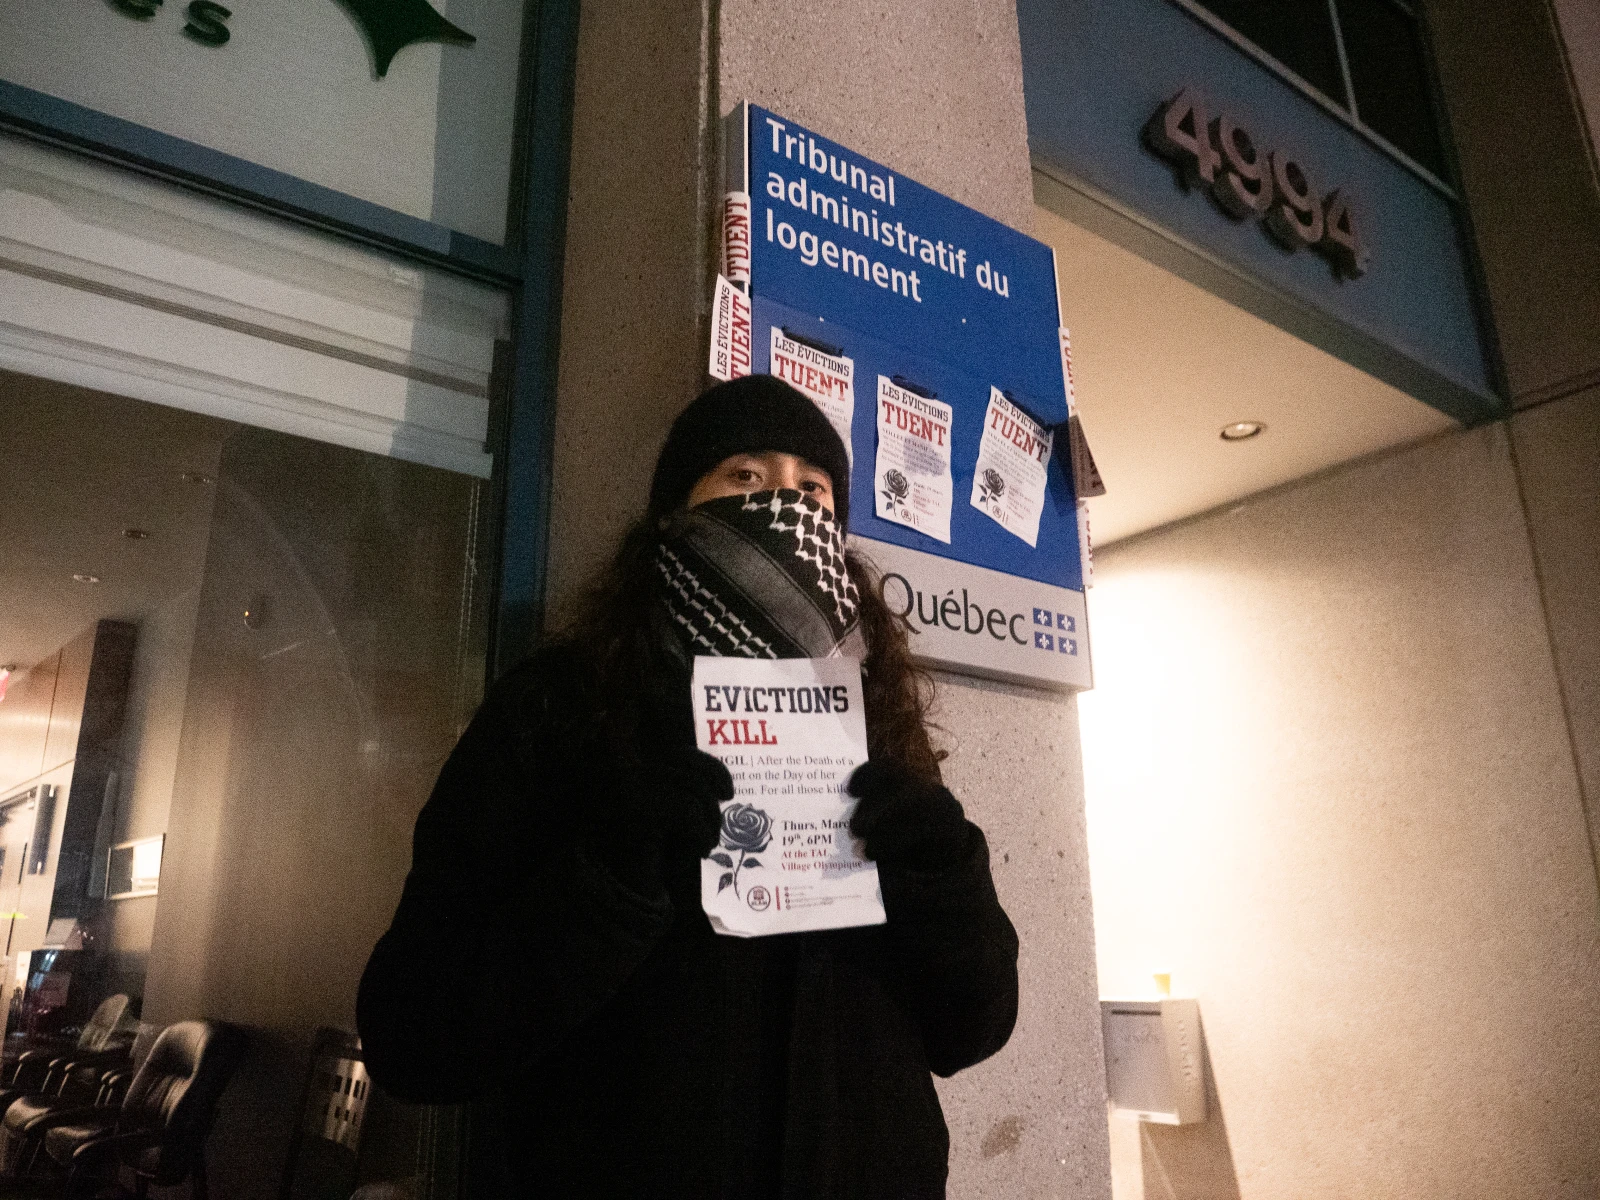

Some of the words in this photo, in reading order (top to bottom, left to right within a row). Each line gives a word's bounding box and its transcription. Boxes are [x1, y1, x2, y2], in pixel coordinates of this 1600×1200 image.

[766, 117, 896, 206] Tribunal
[1152, 87, 1369, 278] 4994
[724, 197, 749, 278] TUENT
[766, 171, 967, 279] administratif
[976, 260, 1010, 298] du
[766, 208, 922, 303] logement
[716, 284, 730, 348] ÉVICTIONS
[775, 336, 795, 354] LES
[717, 350, 728, 376] LES
[774, 353, 849, 402] TUENT
[882, 383, 900, 401] LES
[902, 391, 949, 422] ÉVICTIONS
[994, 393, 1010, 412] LES
[882, 399, 947, 447] TUENT
[990, 407, 1048, 463] TUENT
[879, 572, 1028, 645] Québec
[703, 685, 849, 714] EVICTIONS
[706, 719, 778, 745] KILL
[757, 755, 784, 766] After
[786, 755, 804, 766] the
[804, 755, 833, 766] Death
[835, 755, 847, 766] of
[848, 758, 854, 766] a
[748, 772, 761, 781] on
[764, 769, 780, 781] the
[783, 769, 804, 783] Day
[806, 769, 818, 780] of
[820, 769, 836, 780] her
[761, 784, 778, 796] For
[781, 784, 794, 795] all
[797, 784, 824, 795] those
[781, 820, 817, 831] Thurs,
[821, 818, 850, 830] Marc
[807, 833, 832, 845] 6PM
[781, 862, 811, 872] Village
[782, 850, 792, 859] At
[794, 849, 808, 859] the
